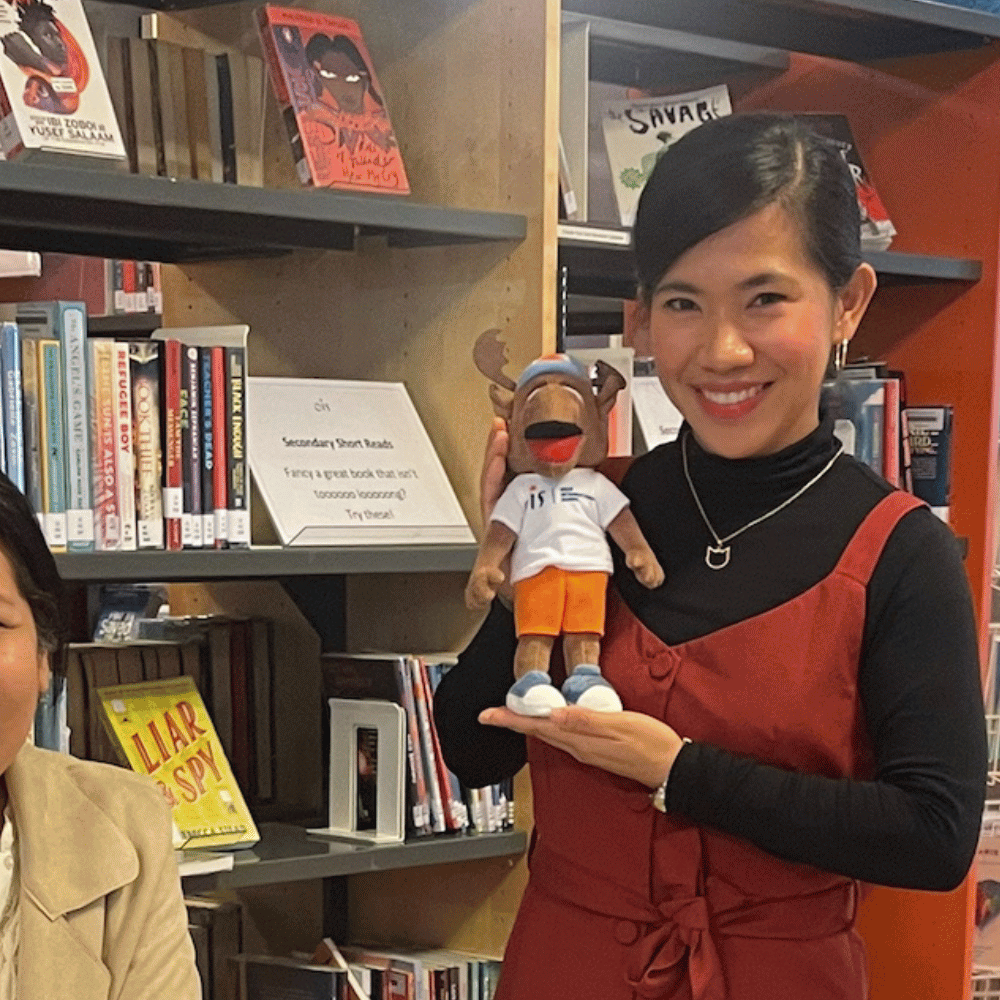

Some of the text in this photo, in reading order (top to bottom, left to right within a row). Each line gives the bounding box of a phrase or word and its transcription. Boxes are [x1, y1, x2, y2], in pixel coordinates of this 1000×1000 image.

[102, 398, 112, 428] SUN
[118, 350, 131, 454] REFUGEE BOY
[203, 354, 214, 471] TEACHER'S DEAD
[230, 378, 243, 414] BLACK
[71, 400, 84, 443] GAME
[104, 430, 113, 445] IS
[231, 416, 244, 459] ENOUGH
[282, 436, 394, 450] Secondary Short Reads
[104, 450, 115, 487] ALSO
[284, 467, 314, 481] Fancy
[316, 470, 322, 479] a
[324, 470, 349, 480] great
[350, 469, 374, 479] book
[375, 469, 396, 479] that
[106, 486, 115, 499] A
[345, 508, 394, 521] Try these!
[131, 701, 206, 774] LIAR
[173, 741, 222, 803] SPY
